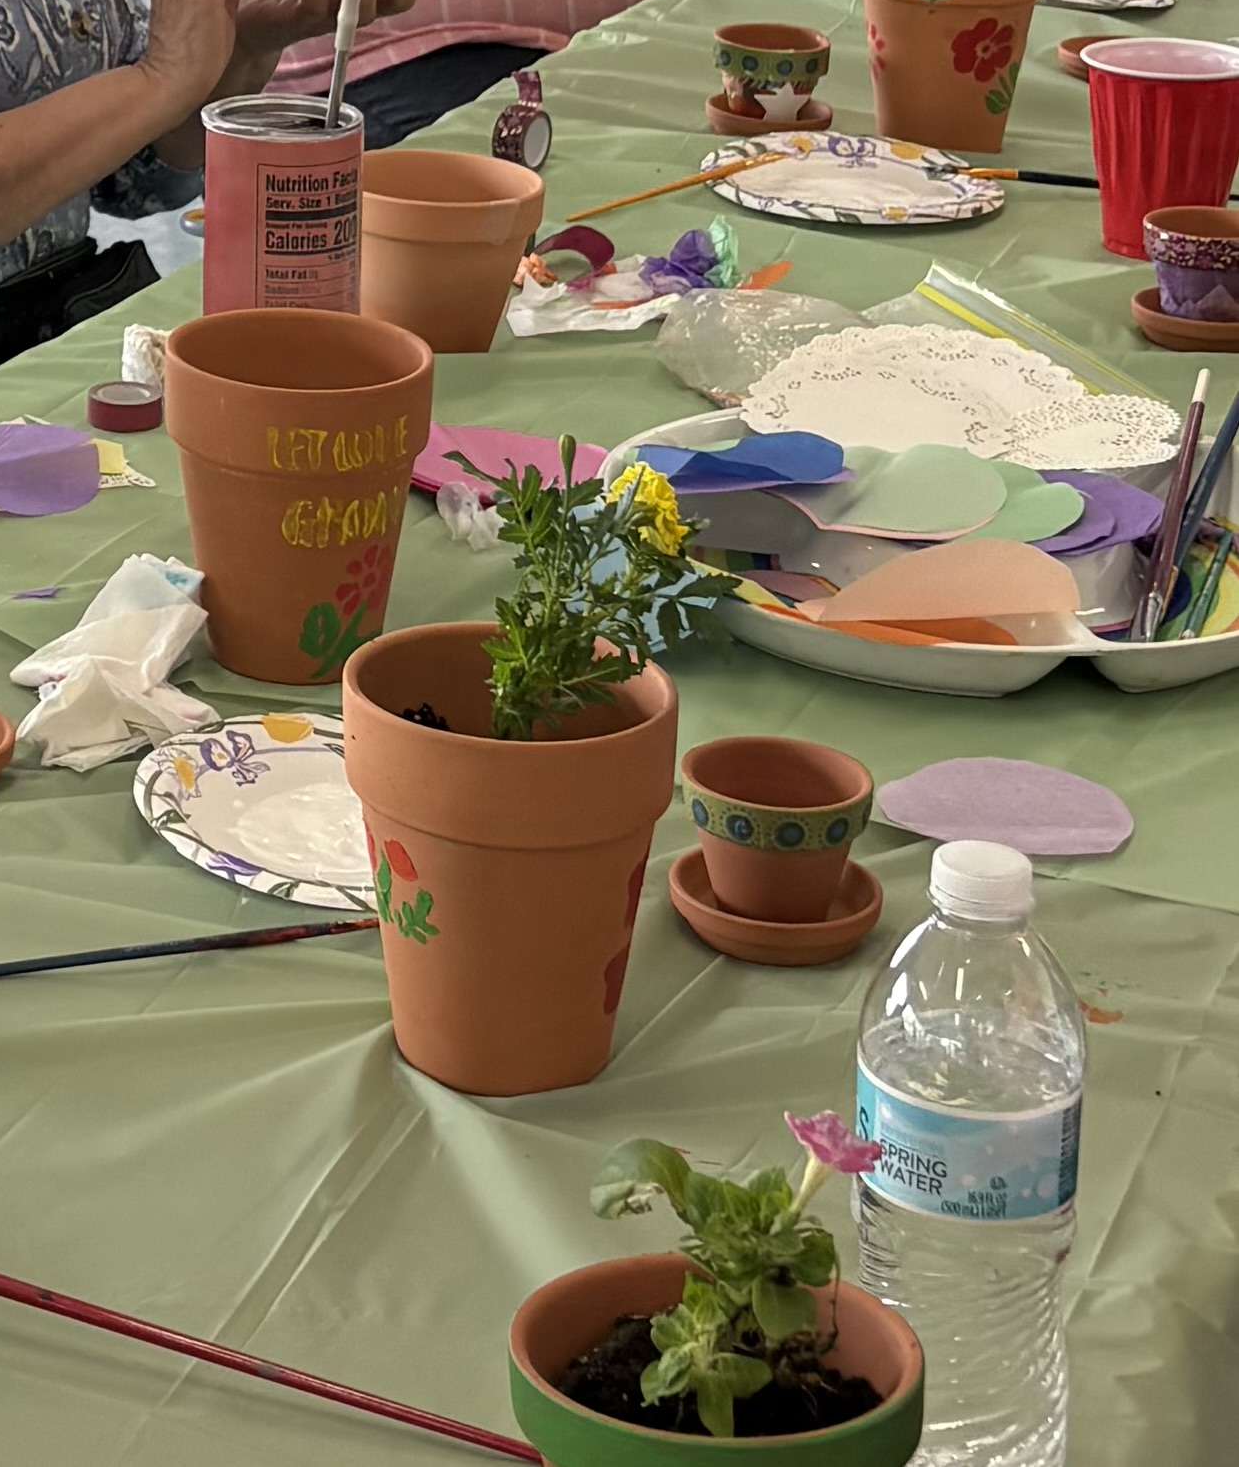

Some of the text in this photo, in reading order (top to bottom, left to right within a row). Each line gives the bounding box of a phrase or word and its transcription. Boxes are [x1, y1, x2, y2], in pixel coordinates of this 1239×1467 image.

[266, 174, 329, 192] Nutrition
[266, 197, 295, 210] Serv.
[298, 197, 322, 209] Size
[326, 195, 332, 206] 1
[265, 230, 328, 251] Calories
[879, 1138, 948, 1179] SPRING
[880, 1155, 943, 1197] WATER
